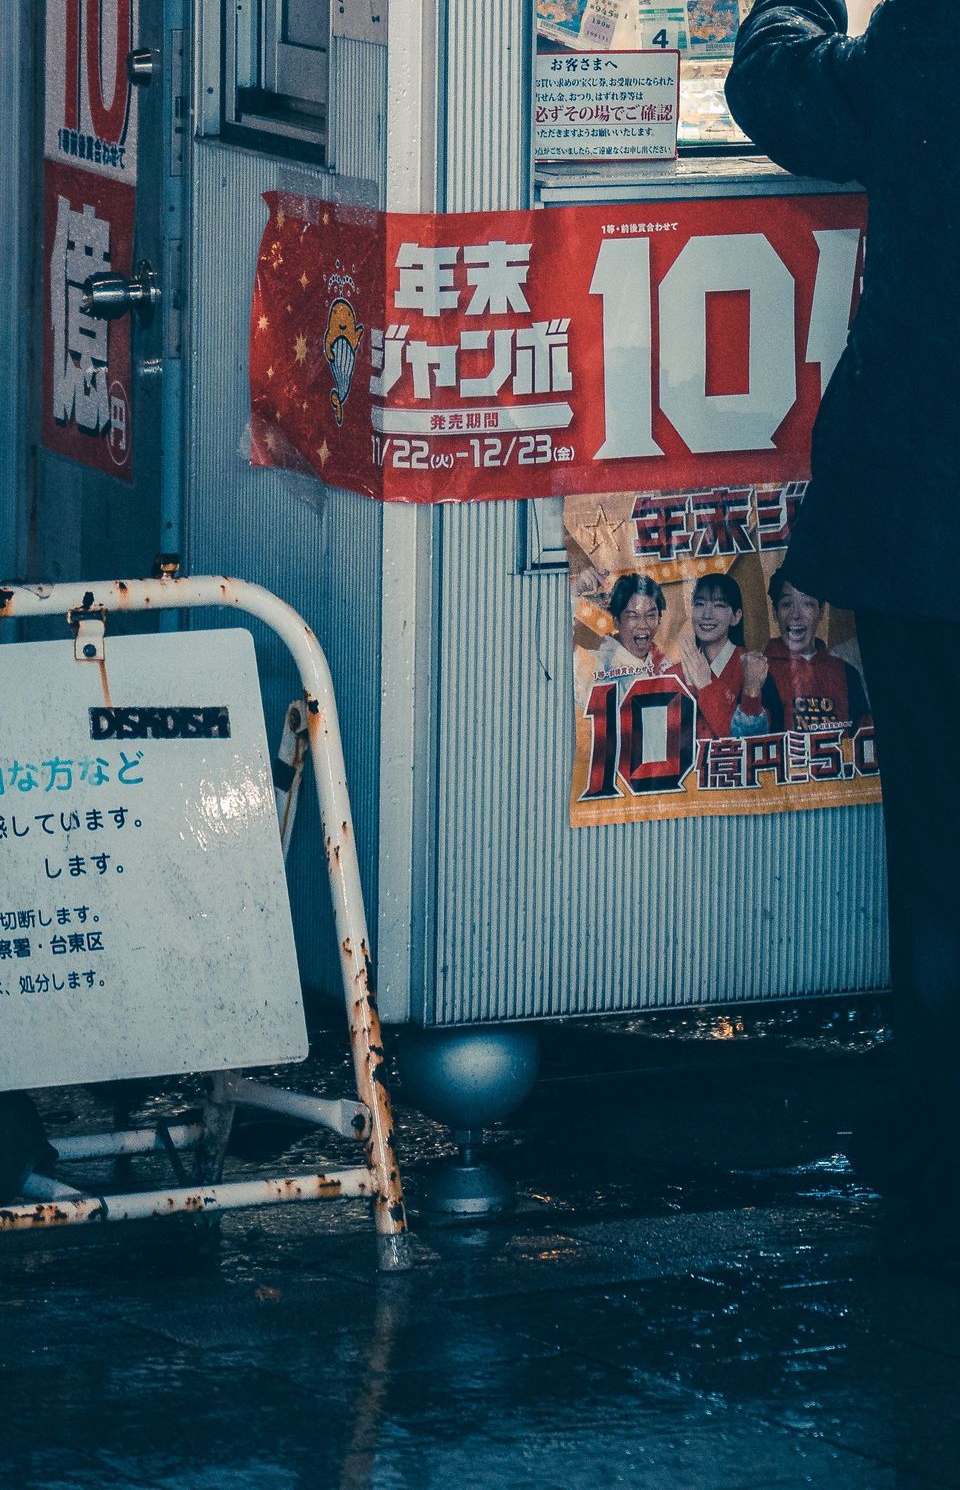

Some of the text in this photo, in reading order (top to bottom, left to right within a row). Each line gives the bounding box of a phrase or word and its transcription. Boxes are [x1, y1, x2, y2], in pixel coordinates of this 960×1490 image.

[651, 28, 669, 48] 4
[551, 57, 618, 72] お客さまへ
[535, 103, 673, 123] 必ずその場でご確認
[394, 241, 533, 318] 年末
[370, 318, 574, 399] ジャンボ
[429, 412, 500, 432] 発売期間
[0, 750, 145, 796] な方など
[0, 806, 143, 839] しています。
[44, 852, 125, 879] します。
[0, 969, 105, 996] 、処分します。
